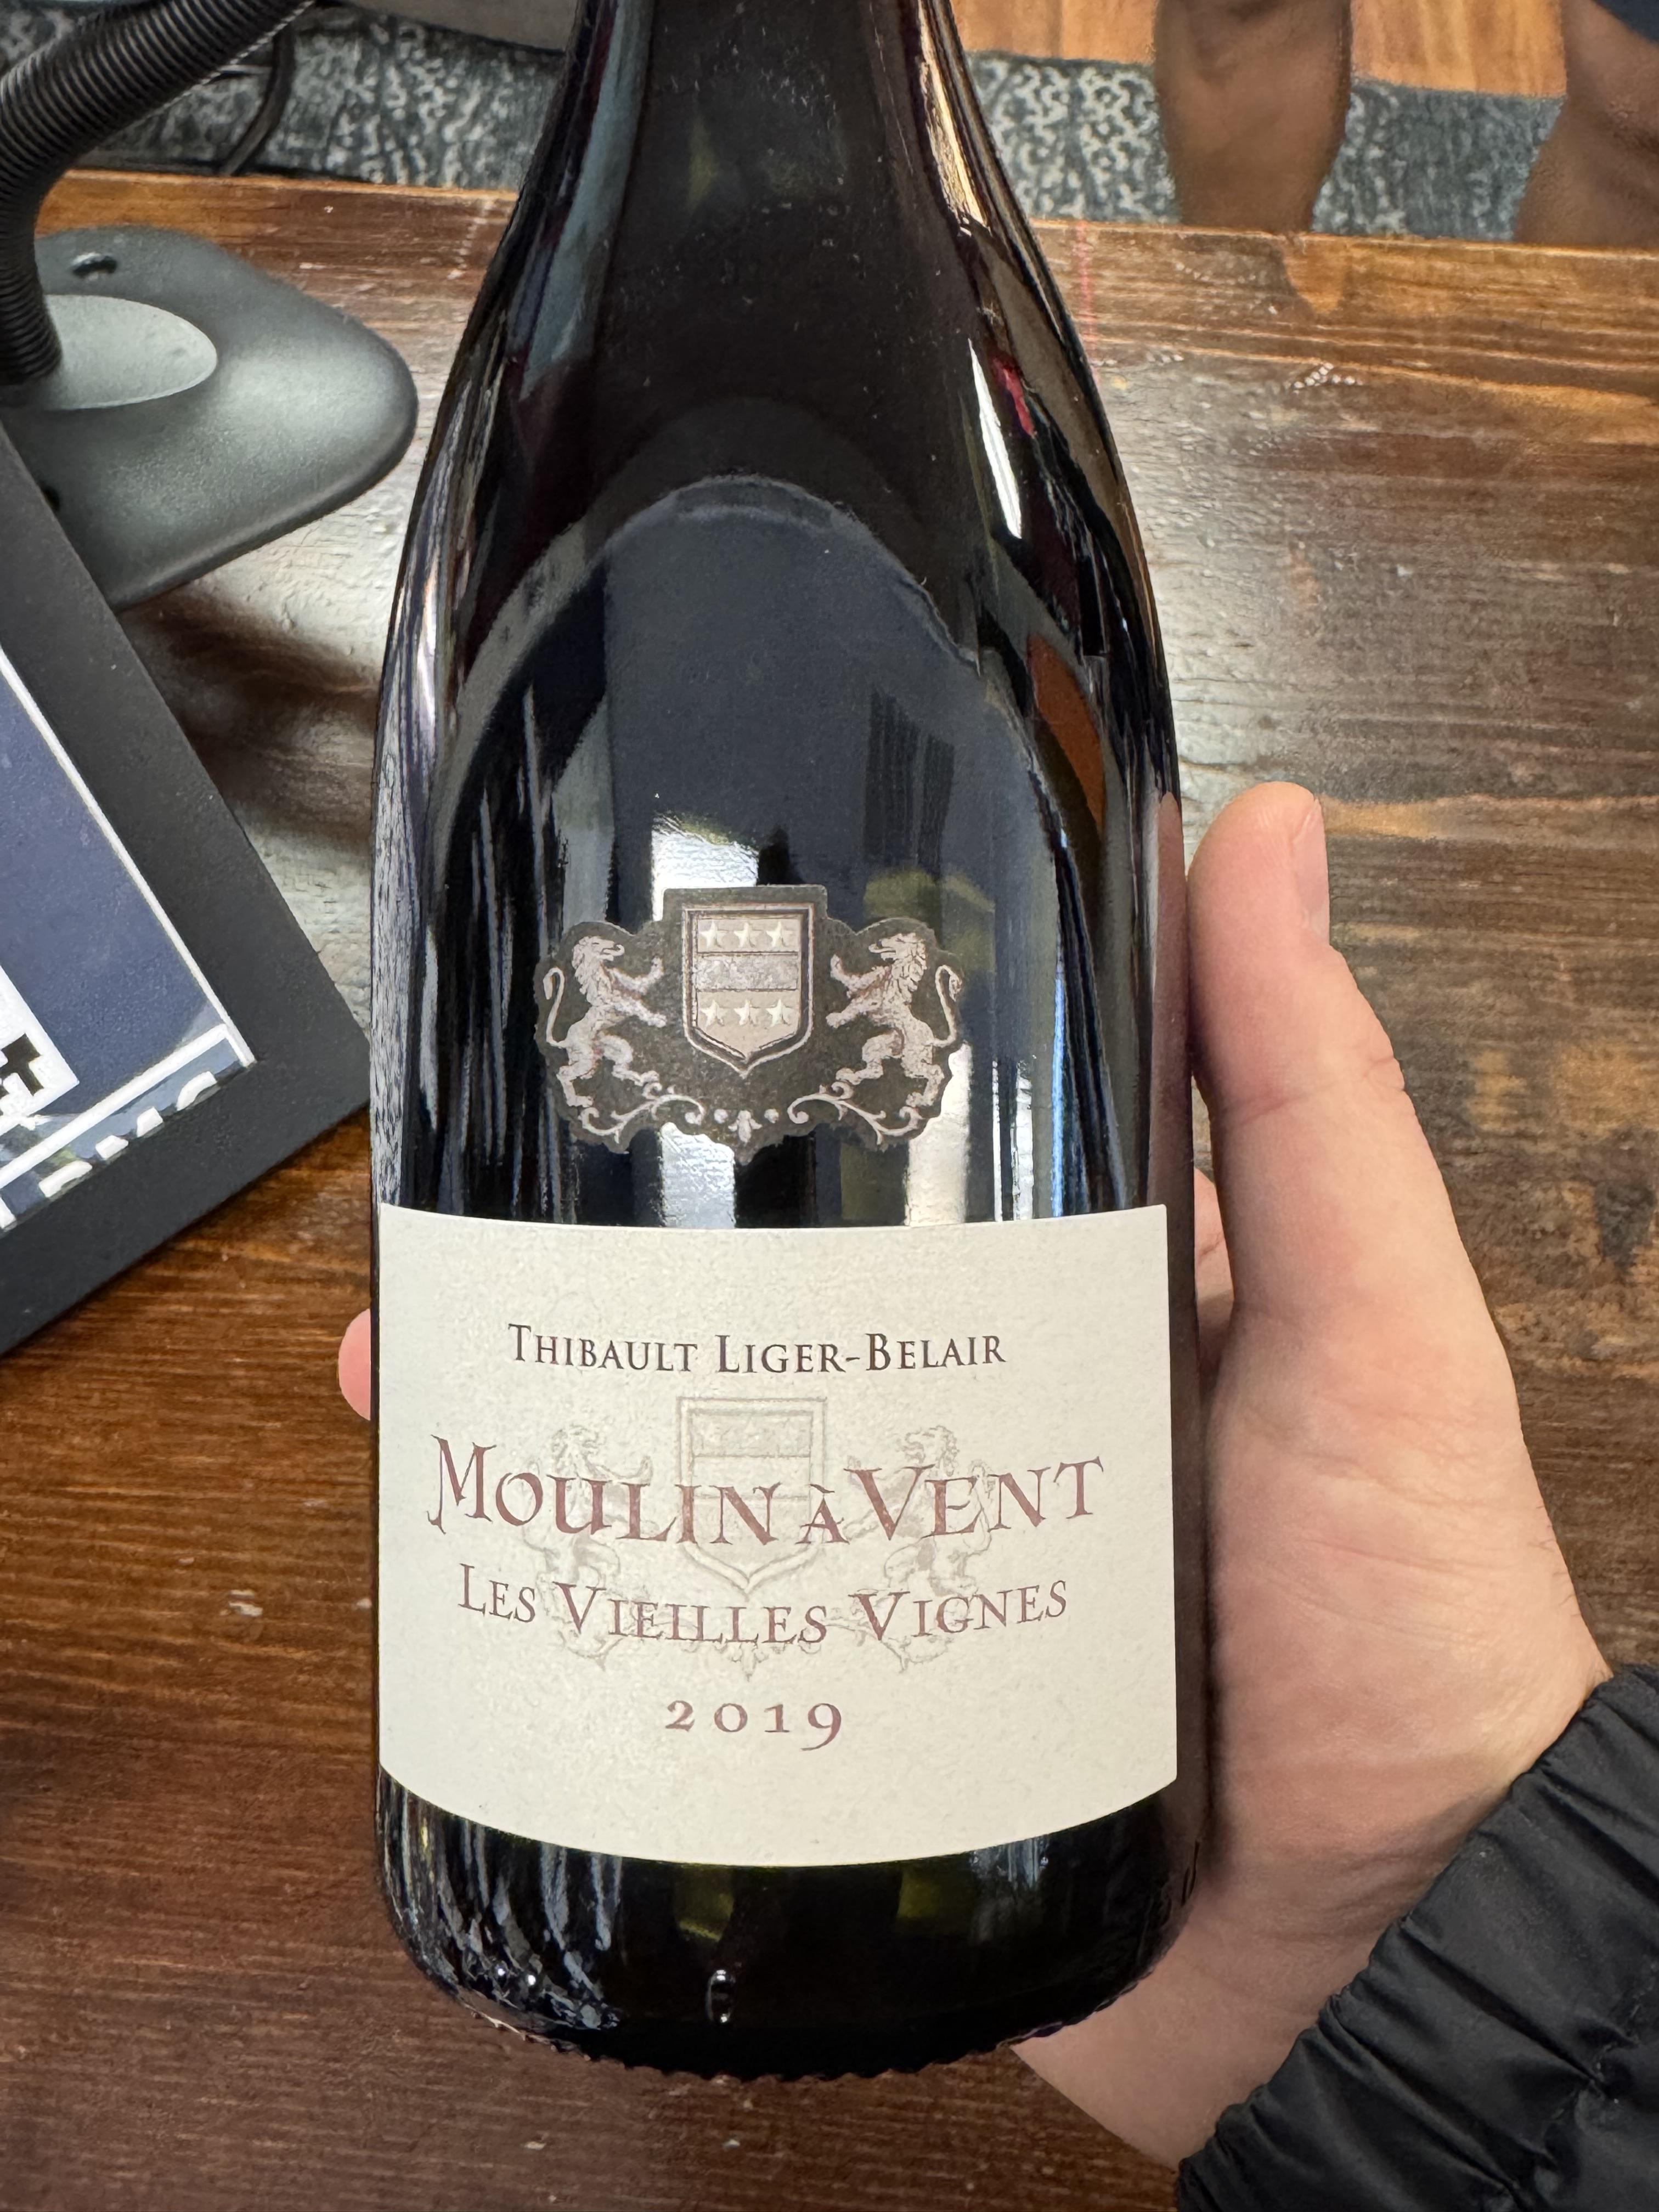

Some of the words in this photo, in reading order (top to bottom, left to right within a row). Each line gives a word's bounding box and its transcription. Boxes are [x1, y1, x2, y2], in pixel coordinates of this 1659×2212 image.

[507, 1324, 698, 1372] THIBAULT
[714, 1333, 1007, 1374] LIGER-BELAIR
[427, 1434, 781, 1545] MOULIN
[844, 1457, 1104, 1541] VENT
[459, 1564, 536, 1623] LES
[552, 1581, 828, 1645] VIEILLES
[848, 1580, 1067, 1641] VIGNES
[665, 1700, 842, 1751] 2019
